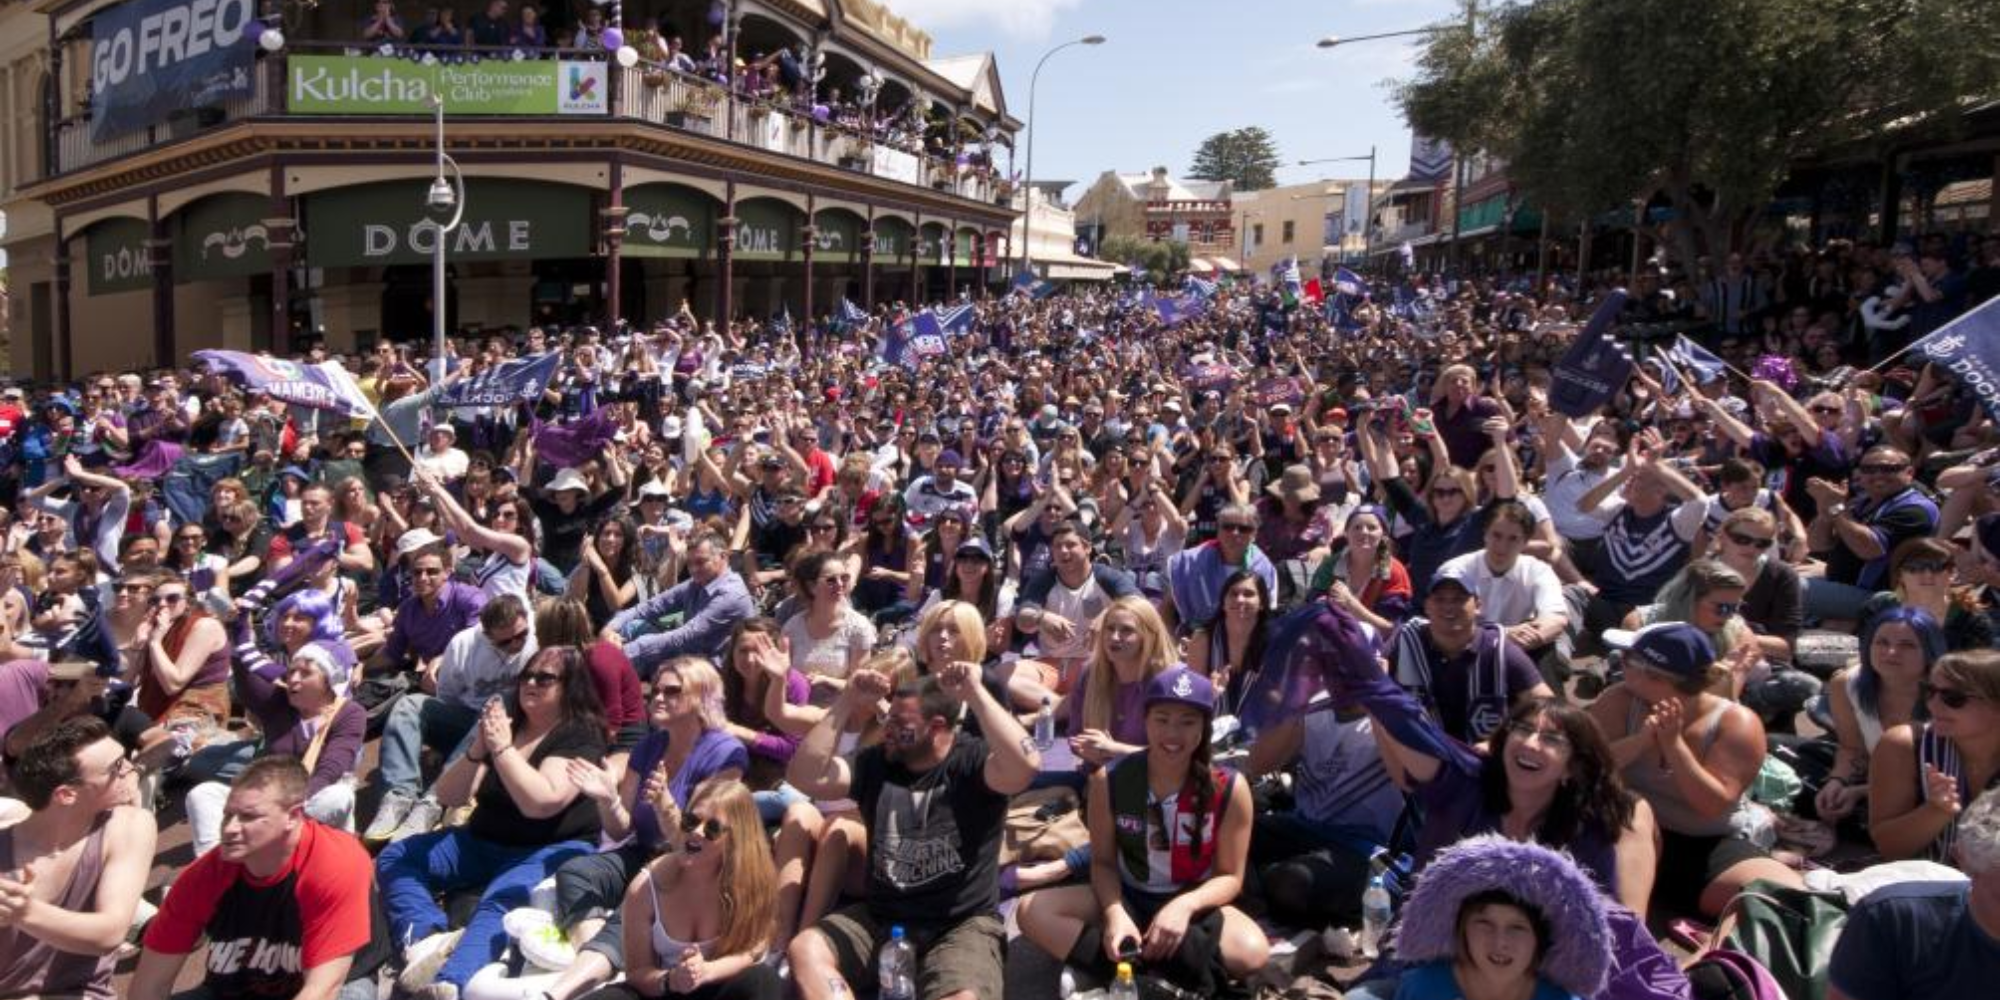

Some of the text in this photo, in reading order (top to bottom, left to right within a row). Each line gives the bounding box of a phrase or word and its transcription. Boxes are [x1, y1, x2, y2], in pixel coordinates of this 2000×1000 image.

[93, 27, 133, 95] GO
[137, 0, 252, 75] FREO
[295, 66, 428, 102] Kulcha
[441, 68, 552, 87] Performance
[451, 86, 491, 102] Club
[363, 217, 530, 256] DÔME
[104, 246, 150, 281] DÔM
[208, 937, 252, 974] THE
